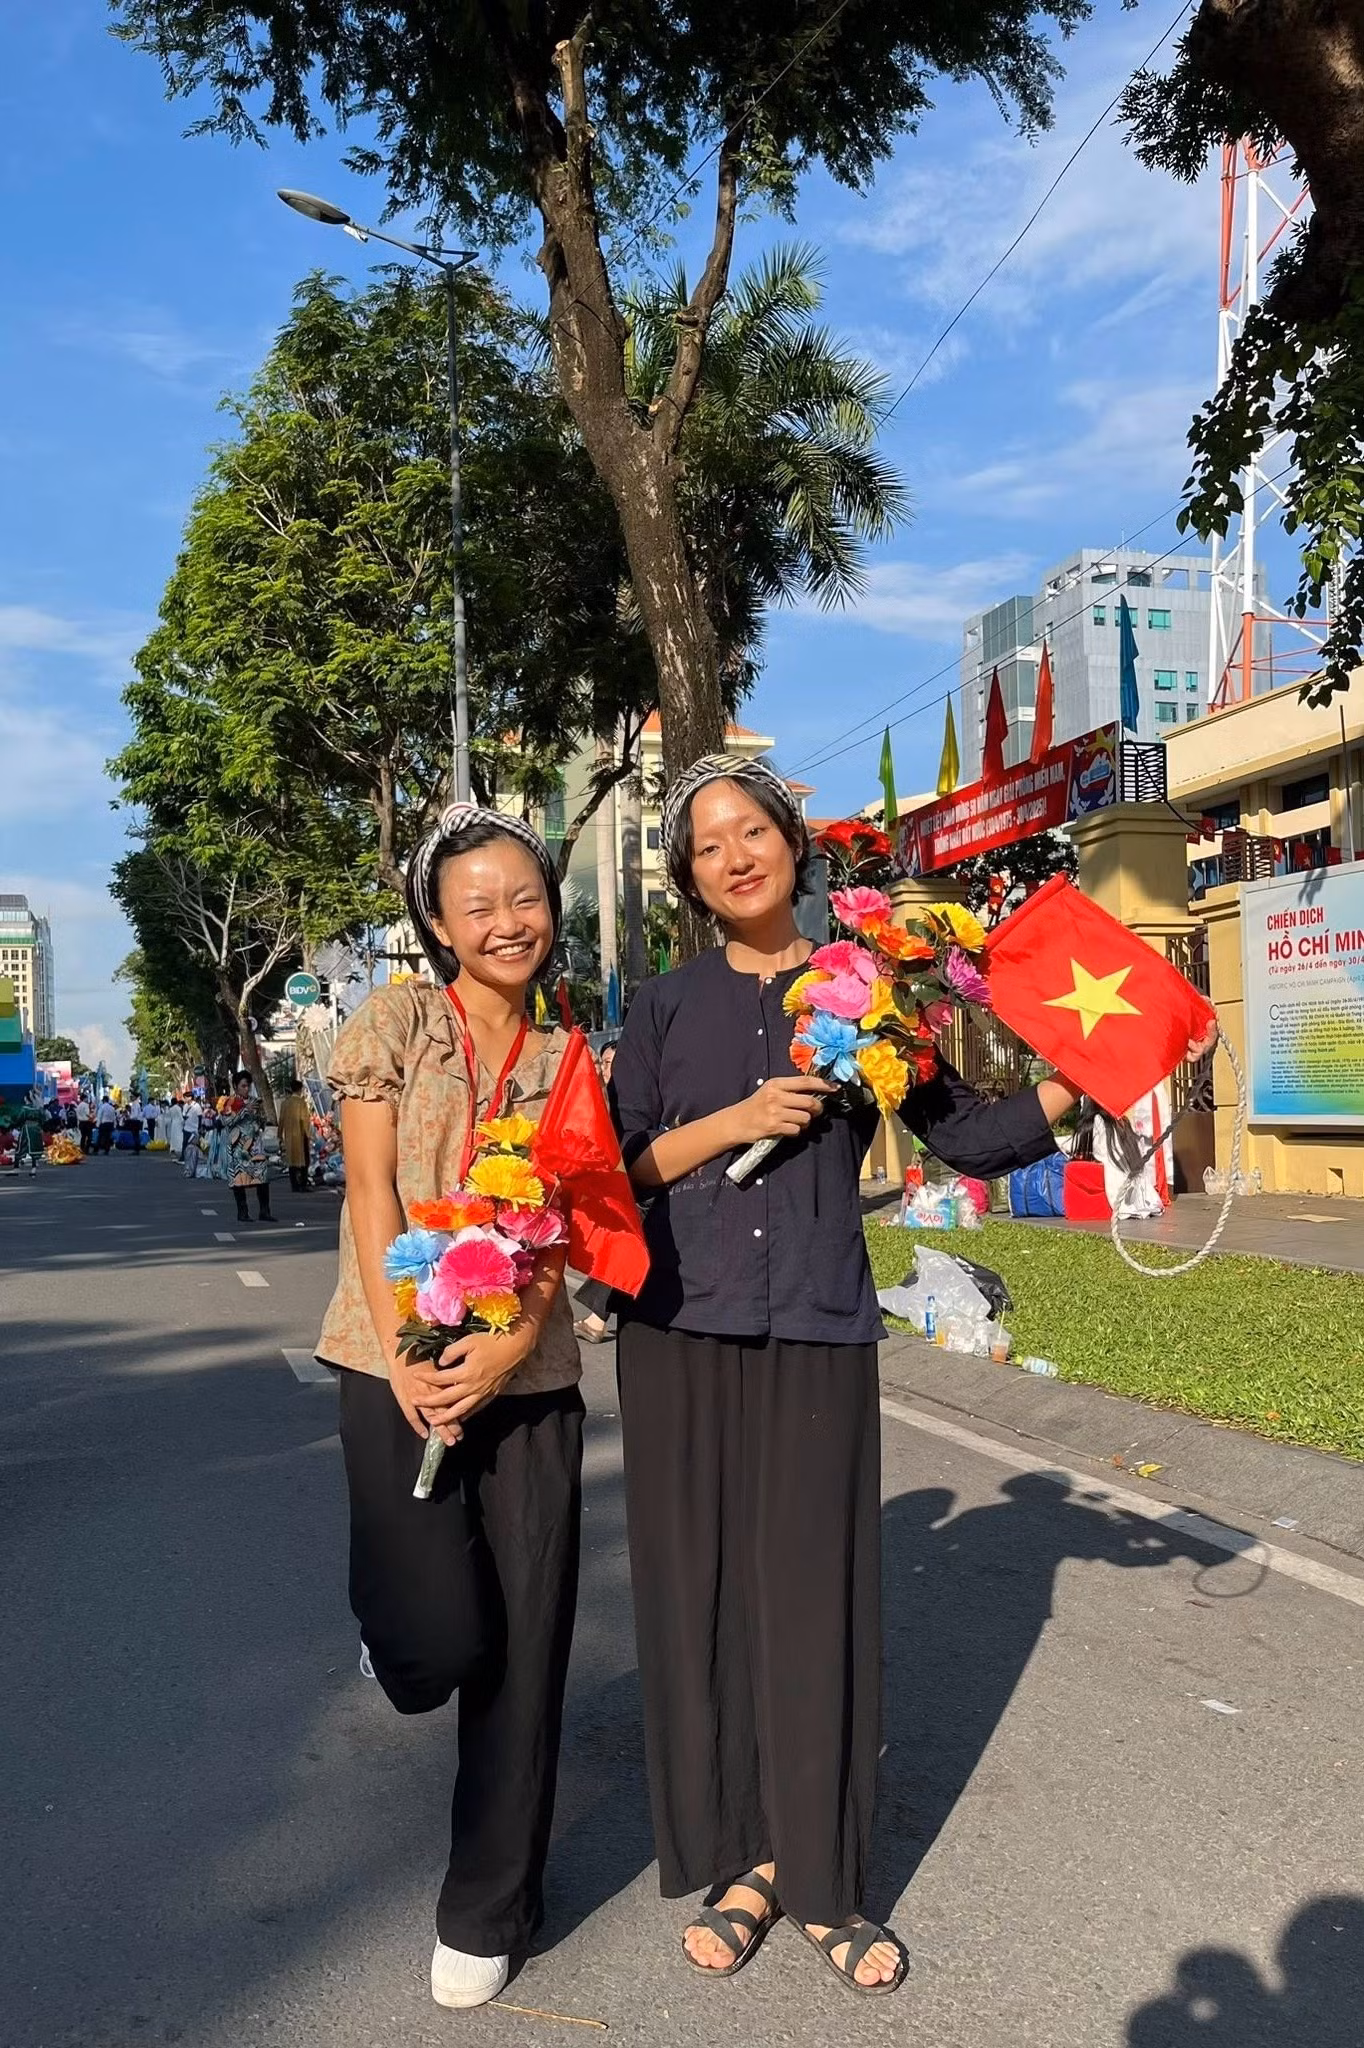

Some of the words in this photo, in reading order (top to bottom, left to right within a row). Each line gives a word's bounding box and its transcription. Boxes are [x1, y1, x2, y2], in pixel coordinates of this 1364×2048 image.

[1267, 907, 1296, 931] CHIẾN
[1299, 907, 1324, 928] DỊCH
[1268, 930, 1293, 961] HỒ
[1298, 928, 1330, 957] CHÍ
[289, 986, 309, 995] BIDV
[916, 1212, 943, 1224] laVie
